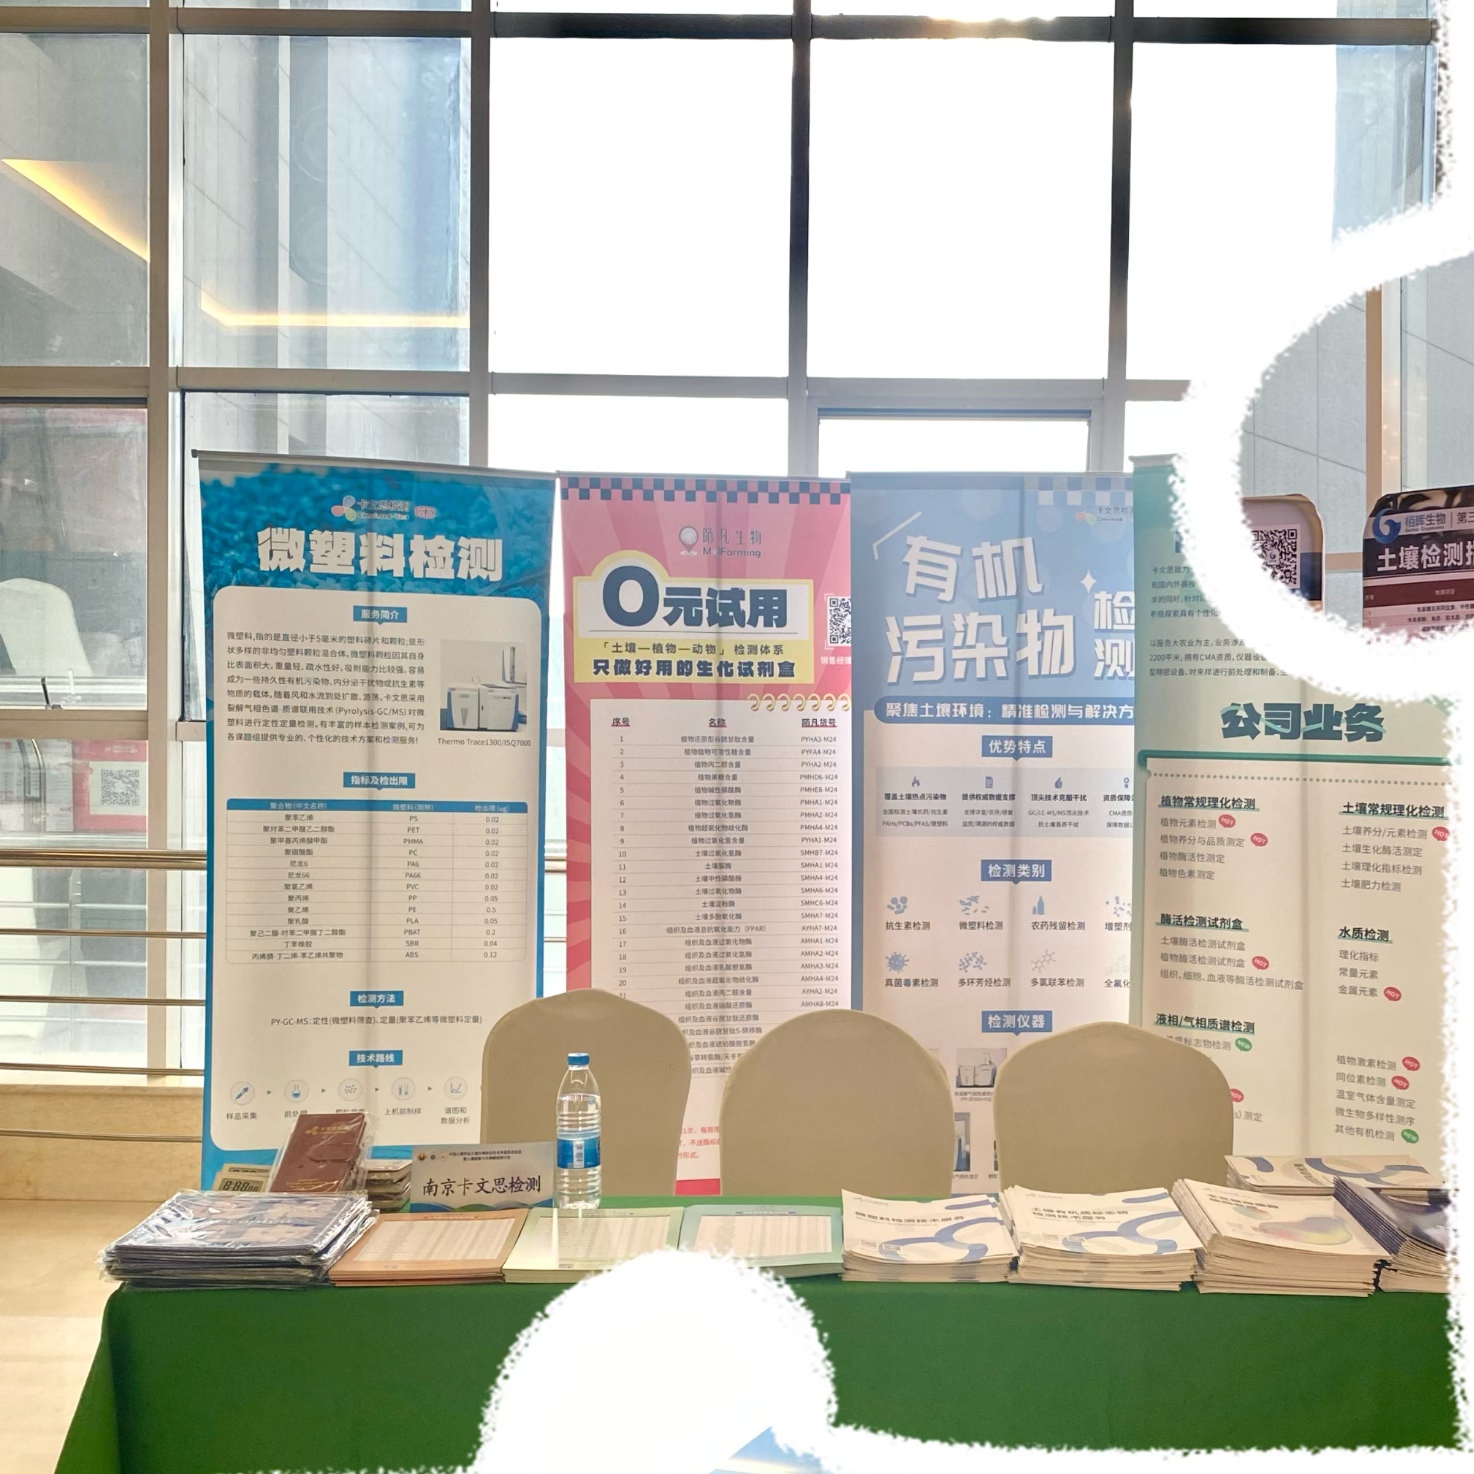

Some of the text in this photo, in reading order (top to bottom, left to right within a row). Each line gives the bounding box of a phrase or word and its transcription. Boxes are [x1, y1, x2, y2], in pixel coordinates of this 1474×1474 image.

[703, 528, 762, 545] 陌凡生物
[257, 527, 502, 581] 微塑料检测
[902, 536, 1044, 602] 有机
[602, 566, 788, 628] 0元试用
[361, 609, 399, 621] 服务简介
[734, 644, 784, 655] 检测体系
[886, 609, 1075, 683] 污染物
[593, 659, 796, 678] 只做好用的生化试剂盒
[612, 717, 836, 727] 序号 名称 陌凡货号
[1221, 703, 1385, 742] 公司业务
[989, 740, 1046, 754] 优势特点
[351, 775, 408, 786] 指标及检出限
[1161, 796, 1445, 819] 植物常规理化检测 土壤常规理化检测
[1160, 817, 1217, 829] 植物元素检测
[1342, 825, 1427, 840] 土壤养分/元素检测
[1160, 834, 1245, 848] 植物养分与品质测定
[1160, 843, 1422, 864] 植物酶活性测定 土壤生化酶活测定
[988, 864, 1045, 878] 检测类别
[1159, 861, 1422, 881] 植物色素测定 土壤理化指标检测
[1341, 879, 1401, 892] 土壤肥力检测
[885, 921, 1085, 931] 抗生素检测 微塑料检测 农药残留检测
[1160, 914, 1389, 942] 酶活检测试剂盒 水质检测
[1160, 953, 1245, 968] 植物酶活检测试剂盒
[885, 978, 1084, 988] 真菌毒素检测 多环芳烃检测 多氯联苯检测
[358, 994, 396, 1004] 检测方法
[988, 1015, 1045, 1028] 检测仪器
[1156, 1013, 1255, 1034] 液相/气相质谱检测
[357, 1053, 395, 1063] 技术路线
[1336, 1055, 1396, 1071] 植物激素检测
[1336, 1072, 1386, 1087] 同位素检测
[1336, 1089, 1416, 1109] 温室气体含量测定
[226, 1106, 467, 1121] 样品采集 上机前制样 谱图和
[441, 1116, 470, 1125] 数据分析
[1335, 1107, 1415, 1126] 微生物多样性测序
[1334, 1124, 1394, 1141] 其他有机检测
[423, 1176, 541, 1196] 南京卡文思检测
